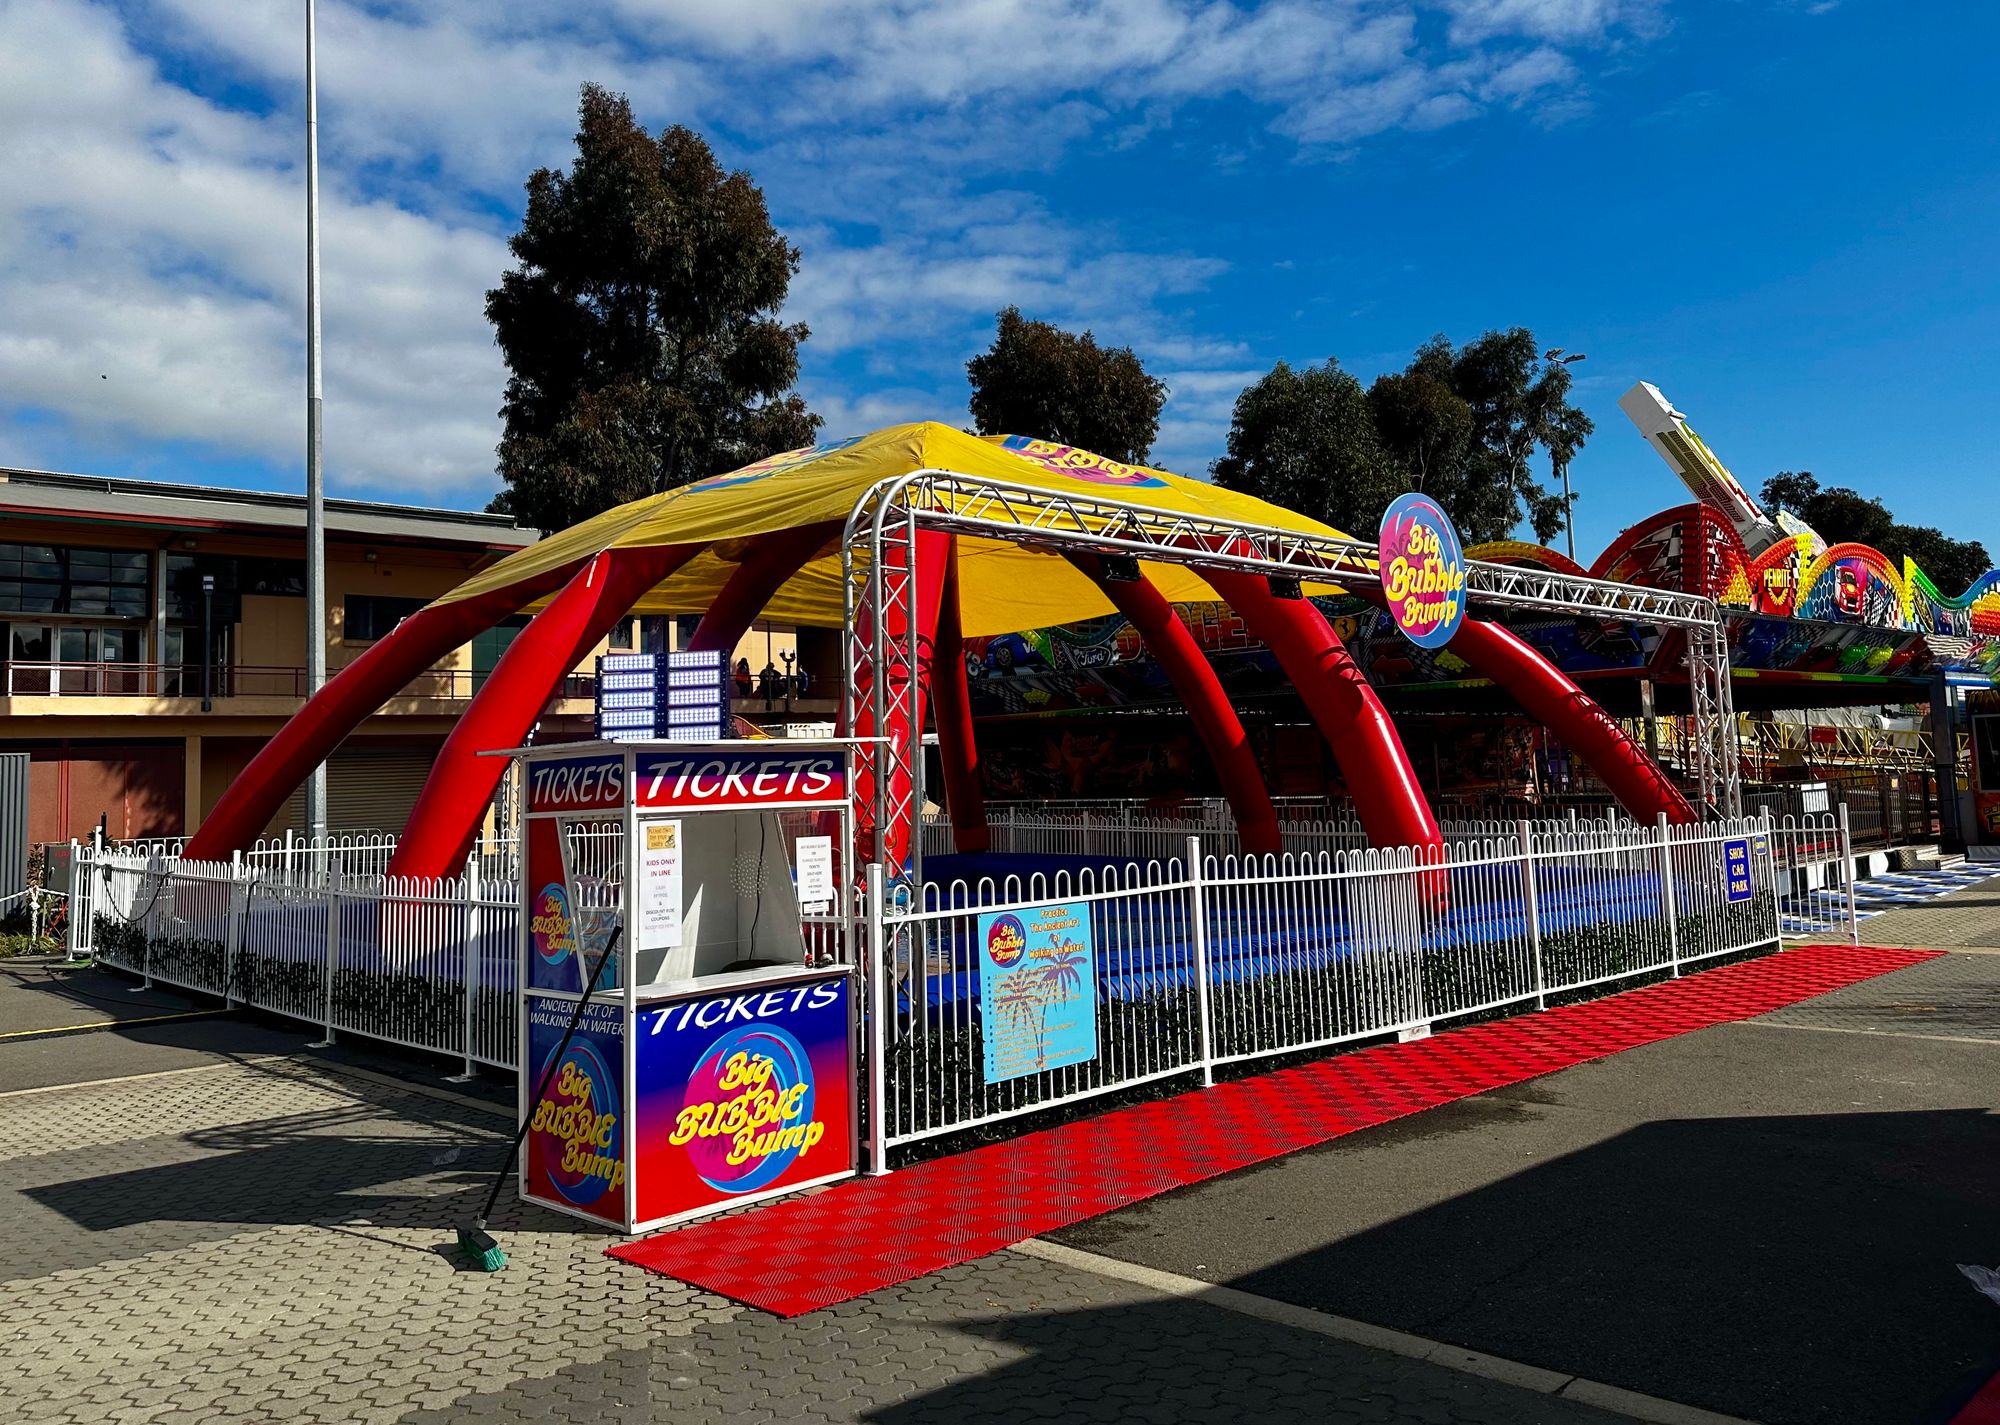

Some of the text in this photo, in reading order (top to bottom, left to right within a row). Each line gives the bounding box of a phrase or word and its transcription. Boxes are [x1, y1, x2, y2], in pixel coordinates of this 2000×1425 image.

[1407, 524, 1440, 563] Big
[1385, 556, 1464, 601] Bubble
[1763, 568, 1792, 588] PENRITE
[1402, 596, 1458, 628] Bump
[1081, 649, 1105, 666] Ford
[534, 763, 623, 805] TICKETS
[647, 759, 834, 799] TICKETS
[1729, 847, 1745, 860] SHOE
[1732, 864, 1746, 876] CAR
[1731, 879, 1749, 893] PARK
[545, 896, 562, 919] Big
[1001, 925, 1015, 939] Big
[1030, 923, 1042, 933] The
[1044, 920, 1068, 931] Ancient
[547, 933, 577, 956] Bump
[989, 936, 1024, 953] Bubble
[995, 950, 1021, 961] Bump
[1029, 947, 1054, 959] Walking
[538, 998, 580, 1014] ANCIENT
[601, 1005, 616, 1018] OF
[650, 981, 842, 1036] TICKETS
[530, 1012, 572, 1029] WALKING
[591, 1020, 625, 1036] WATER
[557, 1061, 592, 1111] Big
[719, 1051, 774, 1101] Big
[725, 1119, 825, 1166] Bump
[561, 1138, 625, 1193] Bump
